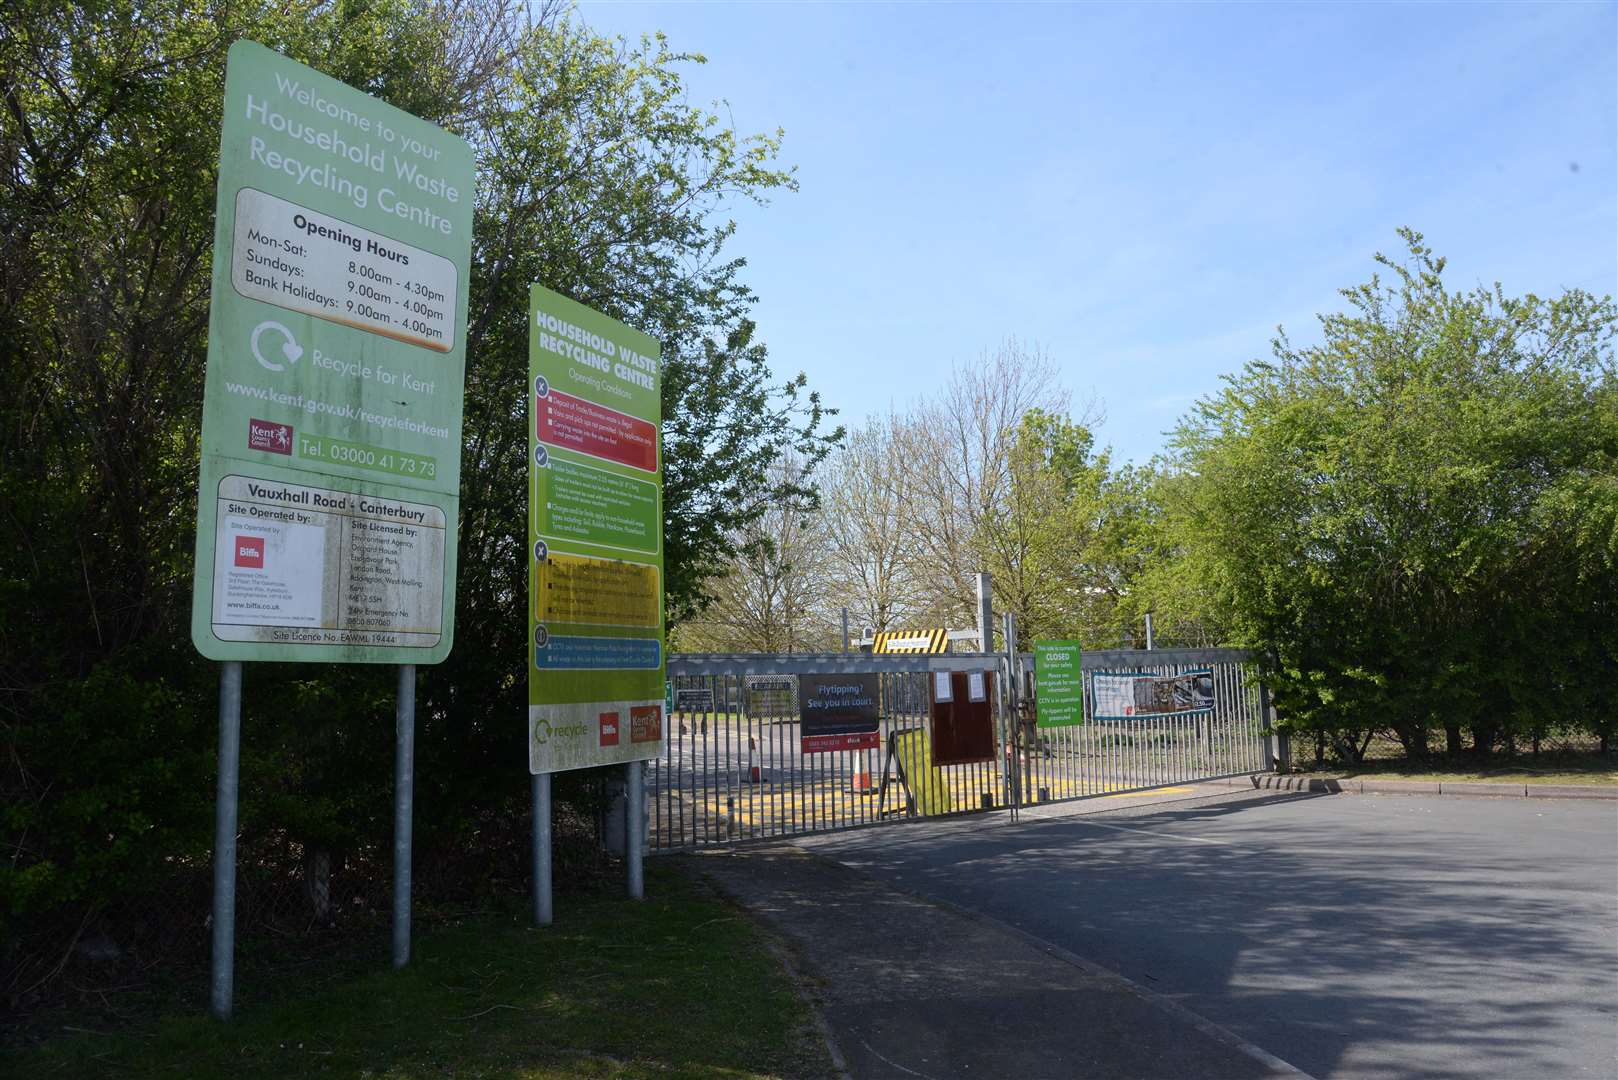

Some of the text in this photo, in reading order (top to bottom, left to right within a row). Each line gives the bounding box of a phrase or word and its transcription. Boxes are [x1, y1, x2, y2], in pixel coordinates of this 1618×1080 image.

[275, 72, 440, 161] Welcome to your
[246, 94, 458, 202] Household Waste
[250, 136, 452, 234] Recycling Centre
[294, 214, 409, 266] Opening Hours
[246, 249, 304, 278] Sundays:
[347, 281, 392, 305] 9.00am
[402, 299, 444, 321] 4.00pm
[248, 228, 307, 258] Mon-Sat:
[348, 261, 392, 286] 8.00am
[404, 281, 444, 302] 4.30pm
[246, 269, 278, 290] Bank
[282, 280, 338, 308] Holidays:
[346, 300, 390, 324] 9.00am
[402, 319, 442, 339] 4.00pm
[536, 310, 657, 374] HOUSEHOLD WASTE
[540, 332, 655, 392] RECYCLING CENTRE
[312, 350, 436, 394] Recycle for Kent
[568, 368, 600, 391] Operating
[226, 381, 448, 439] www.kent.gov.uk/recycleforkent
[252, 425, 274, 438] Kent
[302, 440, 436, 476] Tel. 03000 41 73 73
[228, 504, 311, 524] Site Operated by:
[248, 484, 309, 504] Vauxhall
[314, 494, 346, 510] Road
[360, 500, 424, 522] Canterbury
[352, 520, 418, 537] Site Licensed by:
[273, 631, 290, 640] Site
[292, 632, 322, 641] Licence
[372, 634, 395, 643] 19444
[1046, 653, 1070, 661] CLOSED
[808, 698, 822, 708] See
[824, 700, 840, 710] you
[842, 698, 850, 706] in
[818, 684, 864, 696] Flytipping?
[554, 720, 588, 737] recycle
